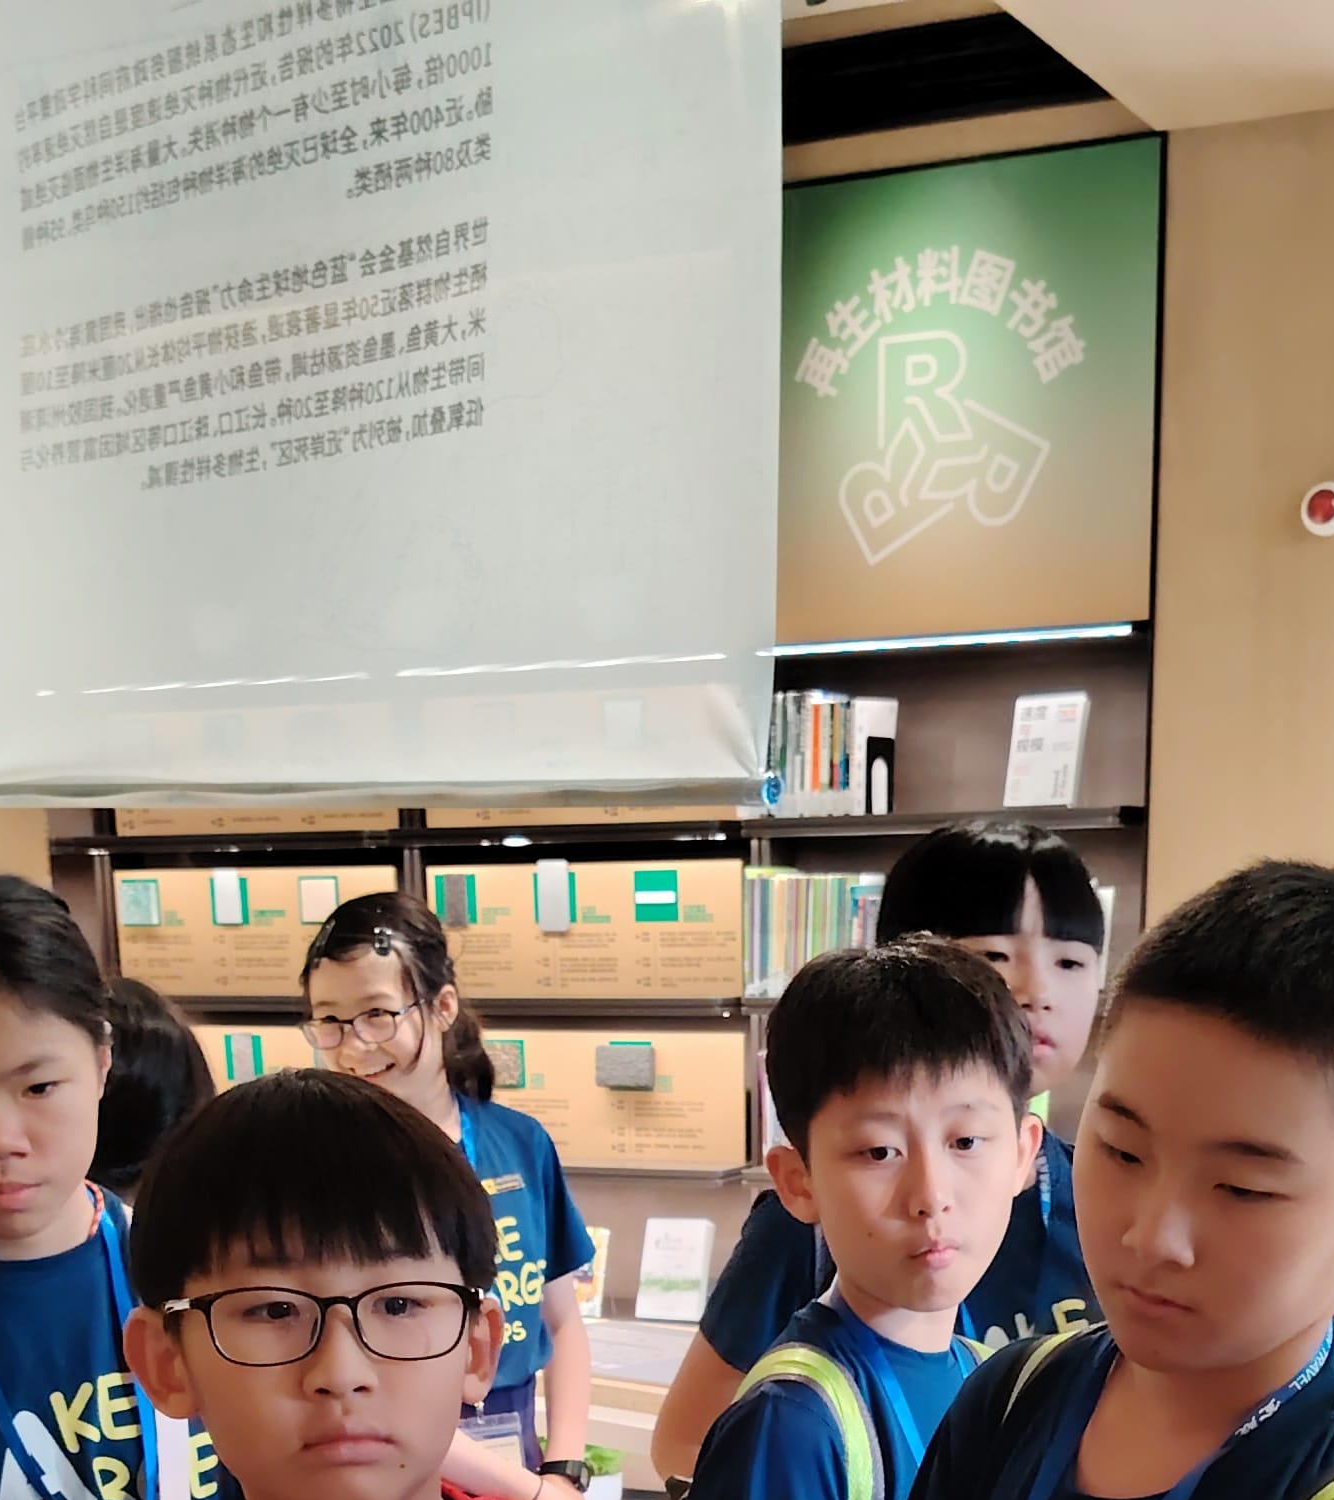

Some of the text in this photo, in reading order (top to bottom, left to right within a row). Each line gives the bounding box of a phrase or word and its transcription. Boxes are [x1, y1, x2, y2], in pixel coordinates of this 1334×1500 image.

[794, 245, 1086, 399] 再生材料图书馆
